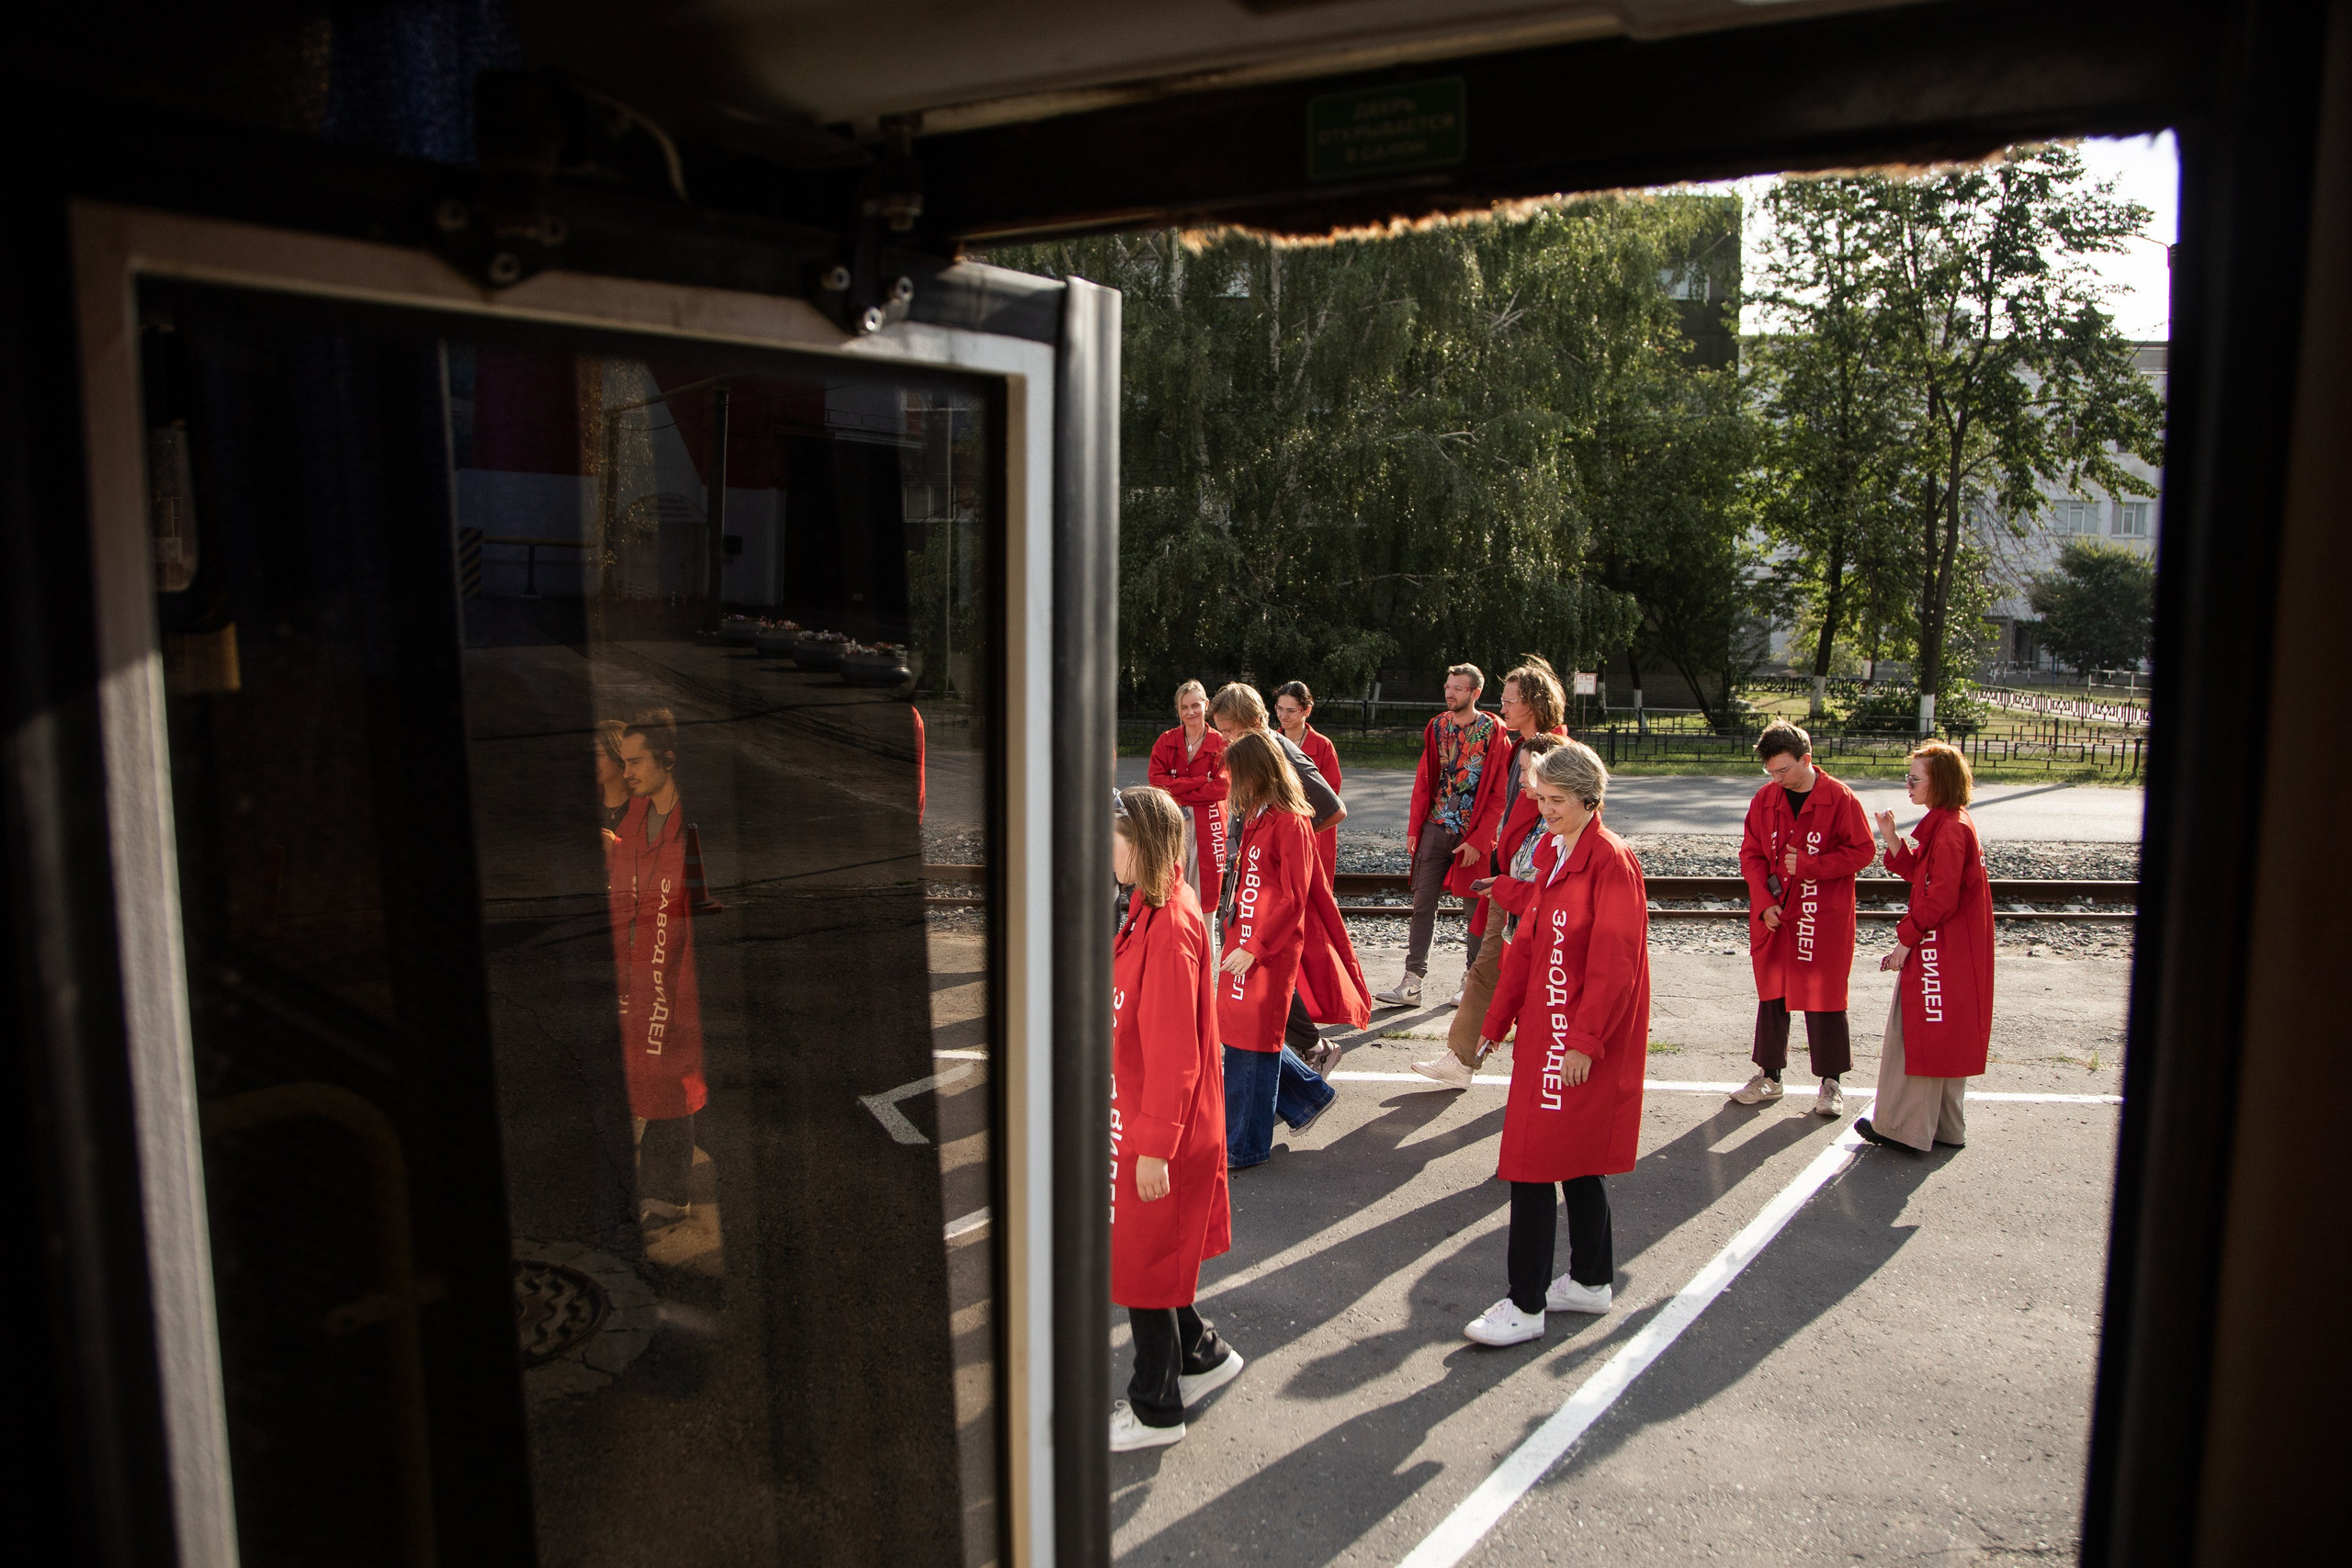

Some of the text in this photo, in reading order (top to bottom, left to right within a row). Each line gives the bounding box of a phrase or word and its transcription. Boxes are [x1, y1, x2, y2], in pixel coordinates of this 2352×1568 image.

[1238, 845, 1261, 919] ЗАВОД
[1800, 831, 1821, 898] ЗАД
[650, 878, 672, 964] ЗАВОД
[1540, 908, 1568, 1111] ЗАВОД ВИДЕЛ
[1921, 948, 1942, 1022] ВИДЕЛ
